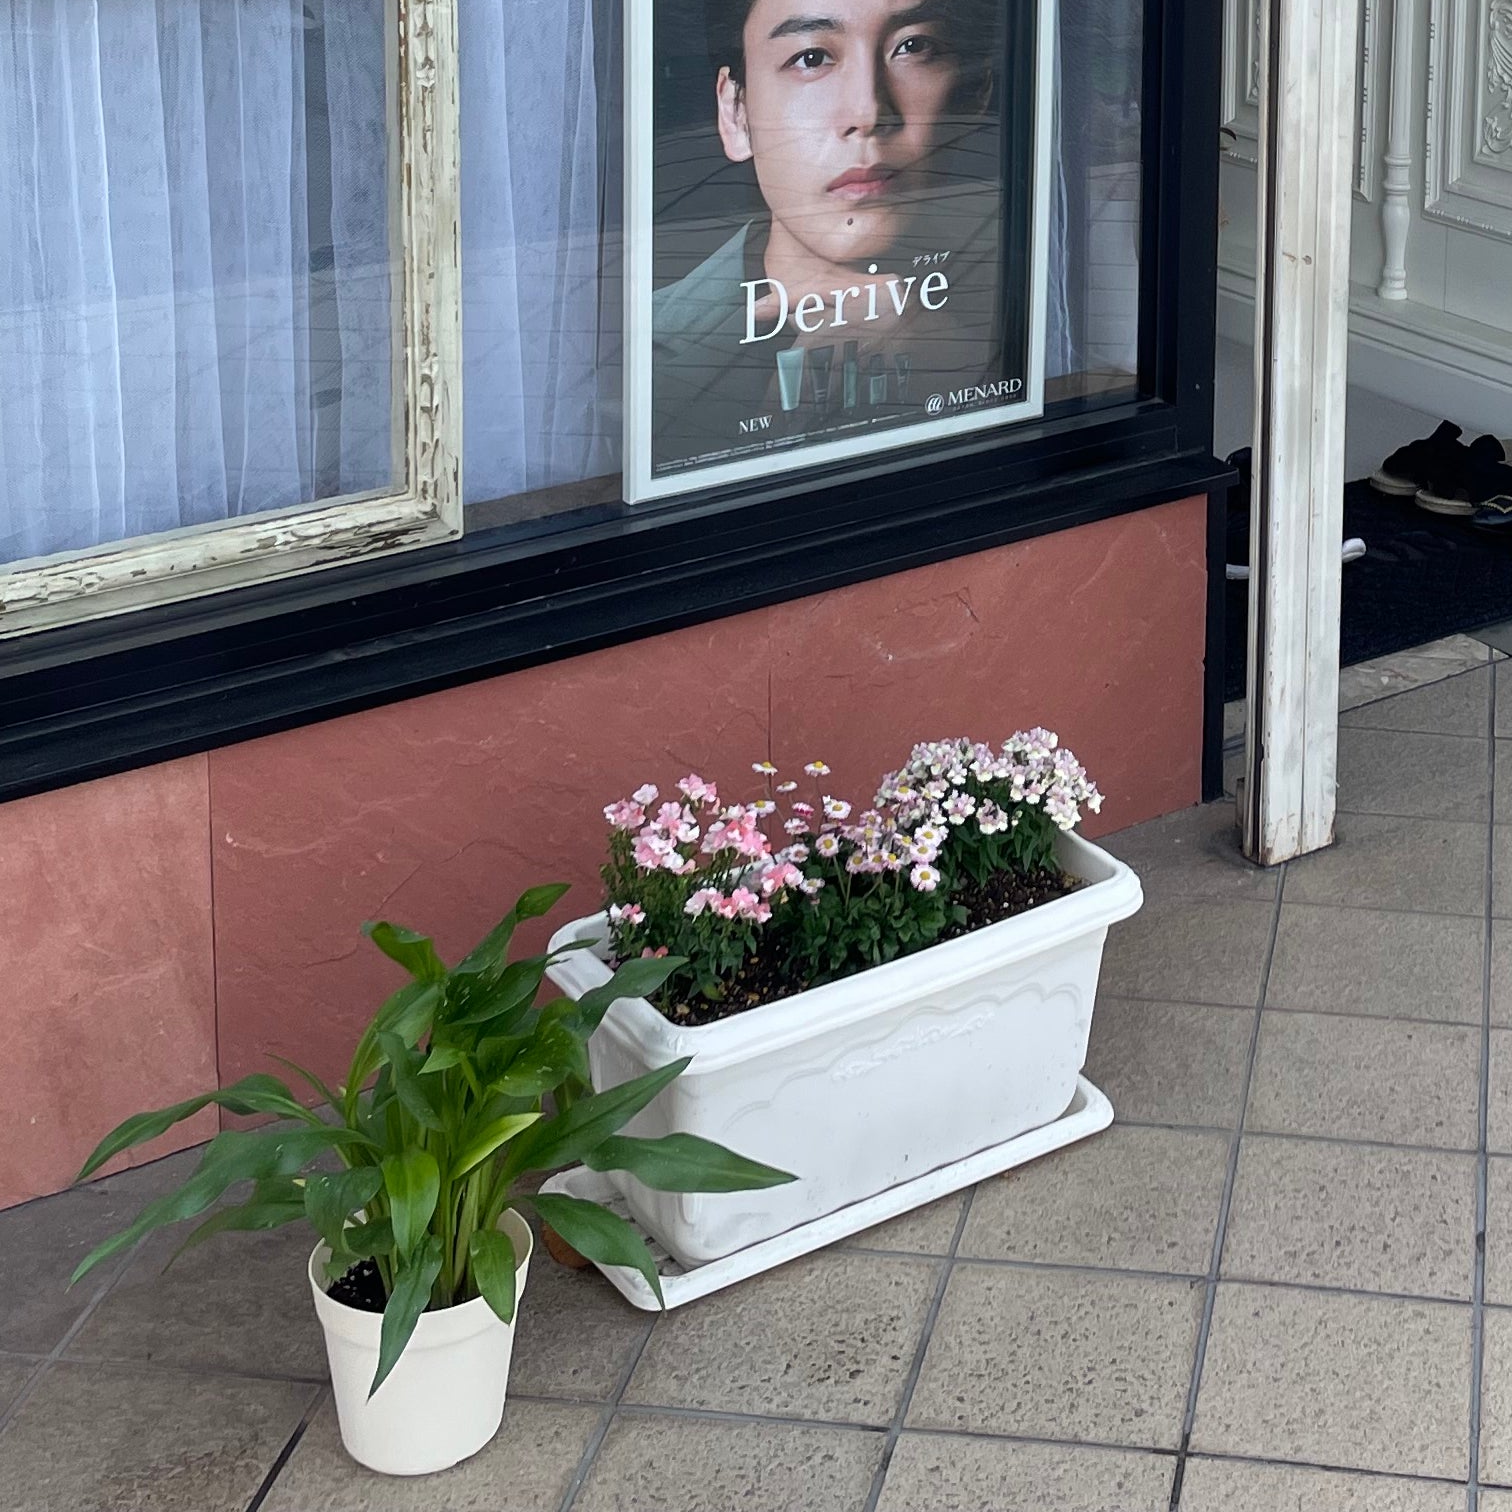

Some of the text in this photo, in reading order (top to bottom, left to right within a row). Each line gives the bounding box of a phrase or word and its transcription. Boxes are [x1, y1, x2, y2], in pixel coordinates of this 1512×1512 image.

[739, 263, 950, 345] Derive
[947, 378, 1023, 407] MENARD
[738, 414, 773, 435] NEW
